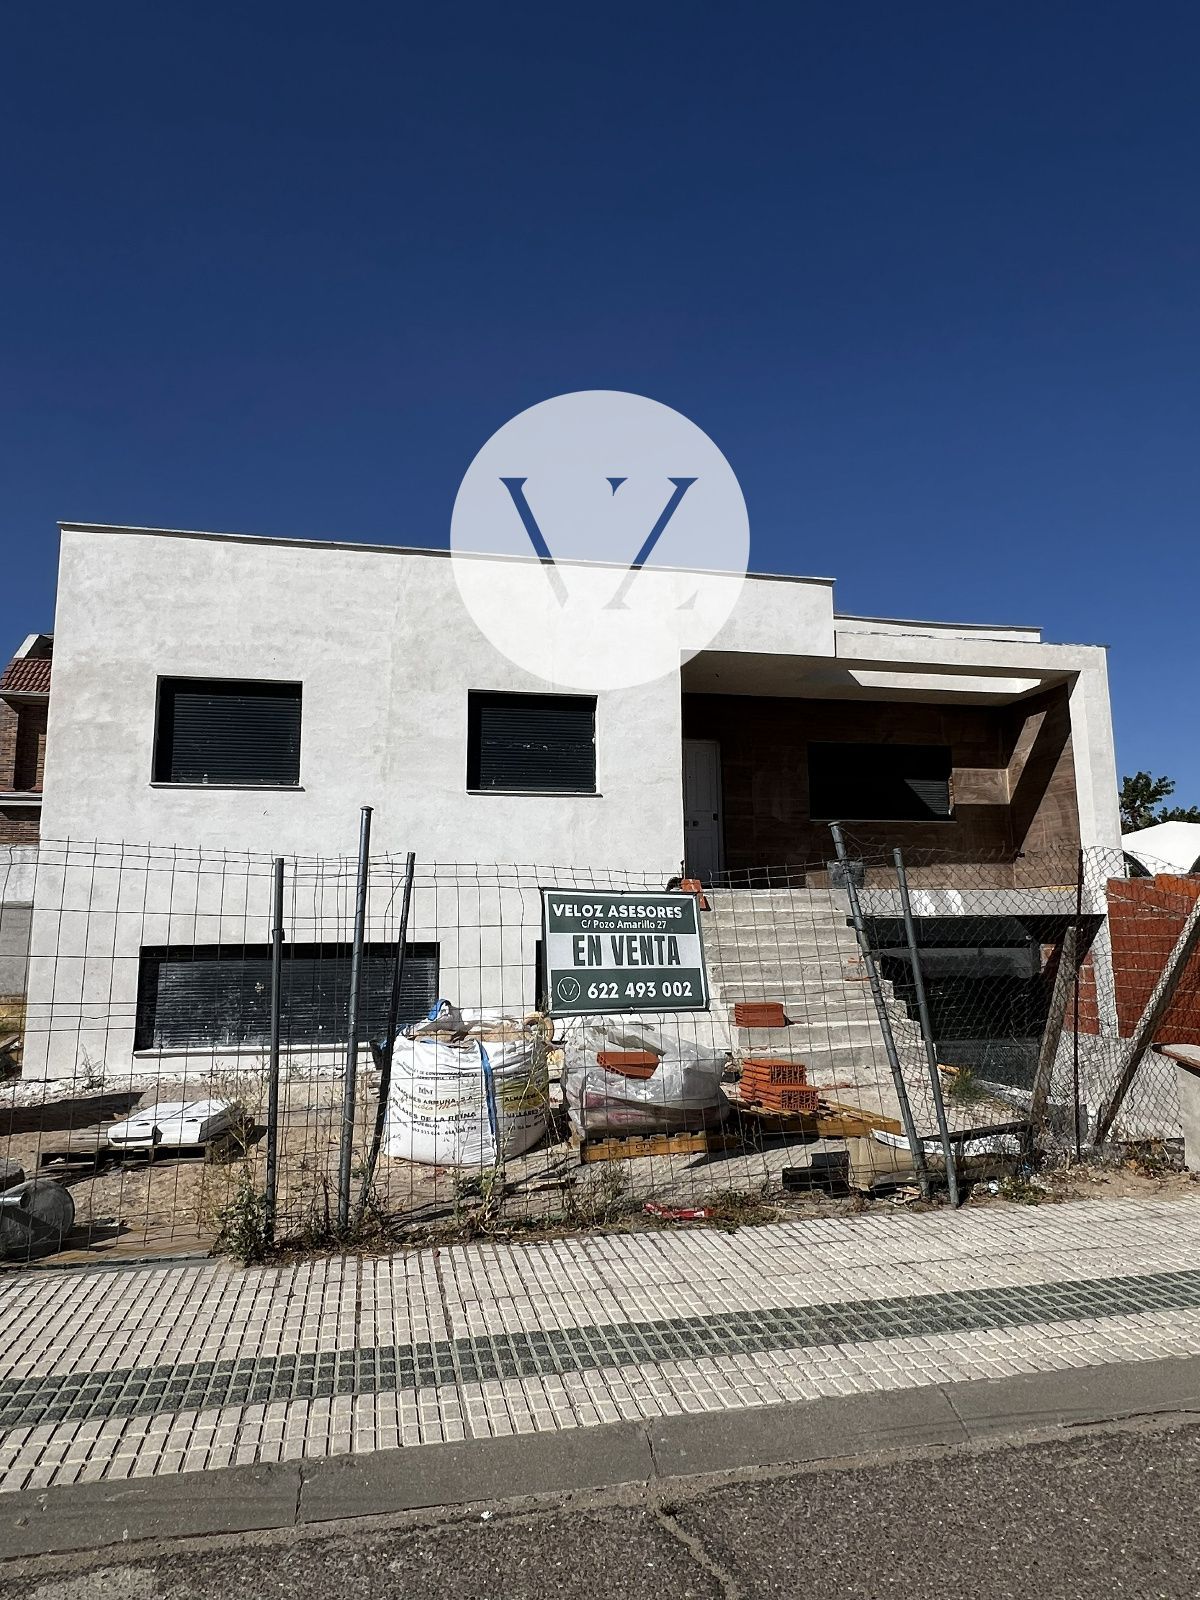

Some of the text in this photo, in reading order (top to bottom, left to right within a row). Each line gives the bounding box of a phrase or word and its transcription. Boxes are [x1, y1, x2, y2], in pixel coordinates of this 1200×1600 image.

[552, 903, 682, 919] VELOZ ASESORES
[581, 920, 667, 929] C/ Pozo Amarillo 27
[572, 935, 681, 966] EN VENTA
[587, 981, 693, 999] 622 493 002
